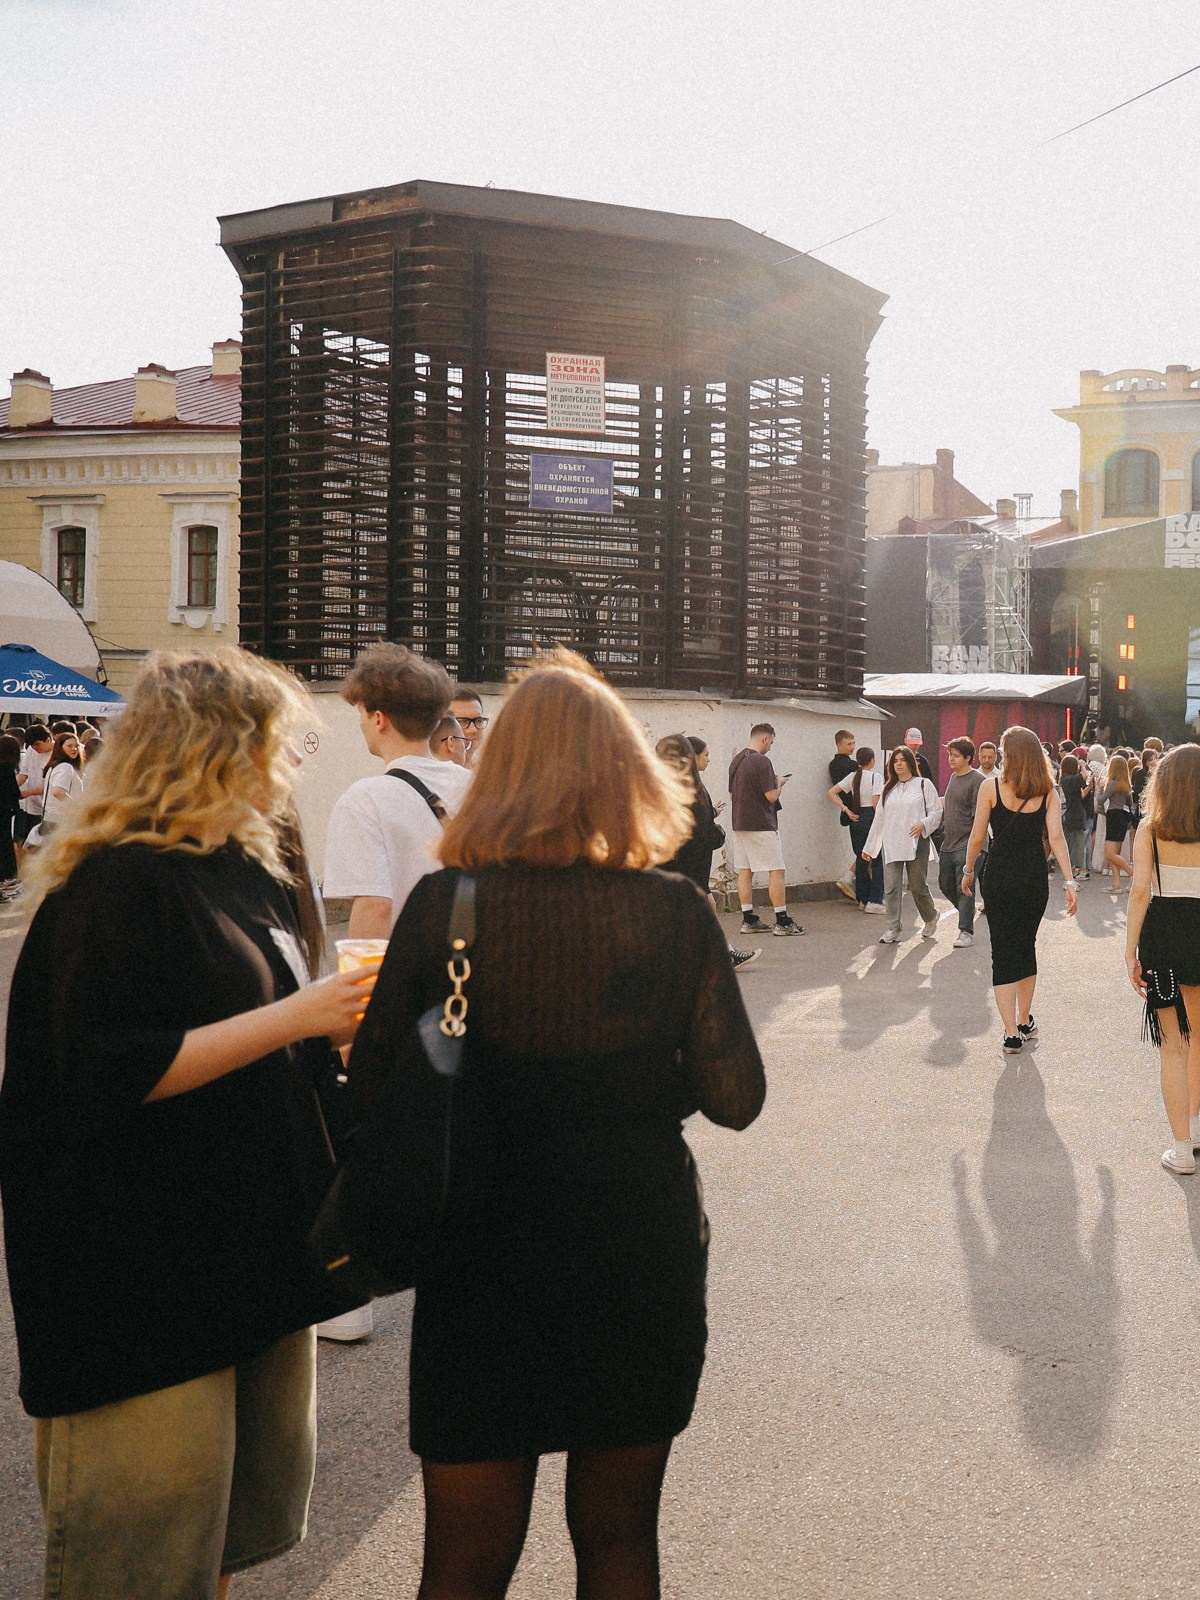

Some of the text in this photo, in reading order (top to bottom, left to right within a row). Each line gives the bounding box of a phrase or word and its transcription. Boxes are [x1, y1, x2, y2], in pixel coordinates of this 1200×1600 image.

[550, 356, 601, 367] ОХРАННАЯ
[551, 364, 600, 375] ЗОНА
[550, 373, 601, 382] МЕТРОПОЛИТЕНА
[574, 386, 584, 394] 25
[550, 394, 602, 404] НЕ ДОПУСКАЕТСЯ
[558, 463, 587, 472] ОБЪЕКТ
[549, 473, 595, 483] ОХРАНЯЕТСЯ
[534, 483, 609, 496] ВНЕВЕДОМСТВЕННОЙ
[555, 496, 588, 505] ОХРАНОЙ
[2, 679, 88, 696] Жигули
